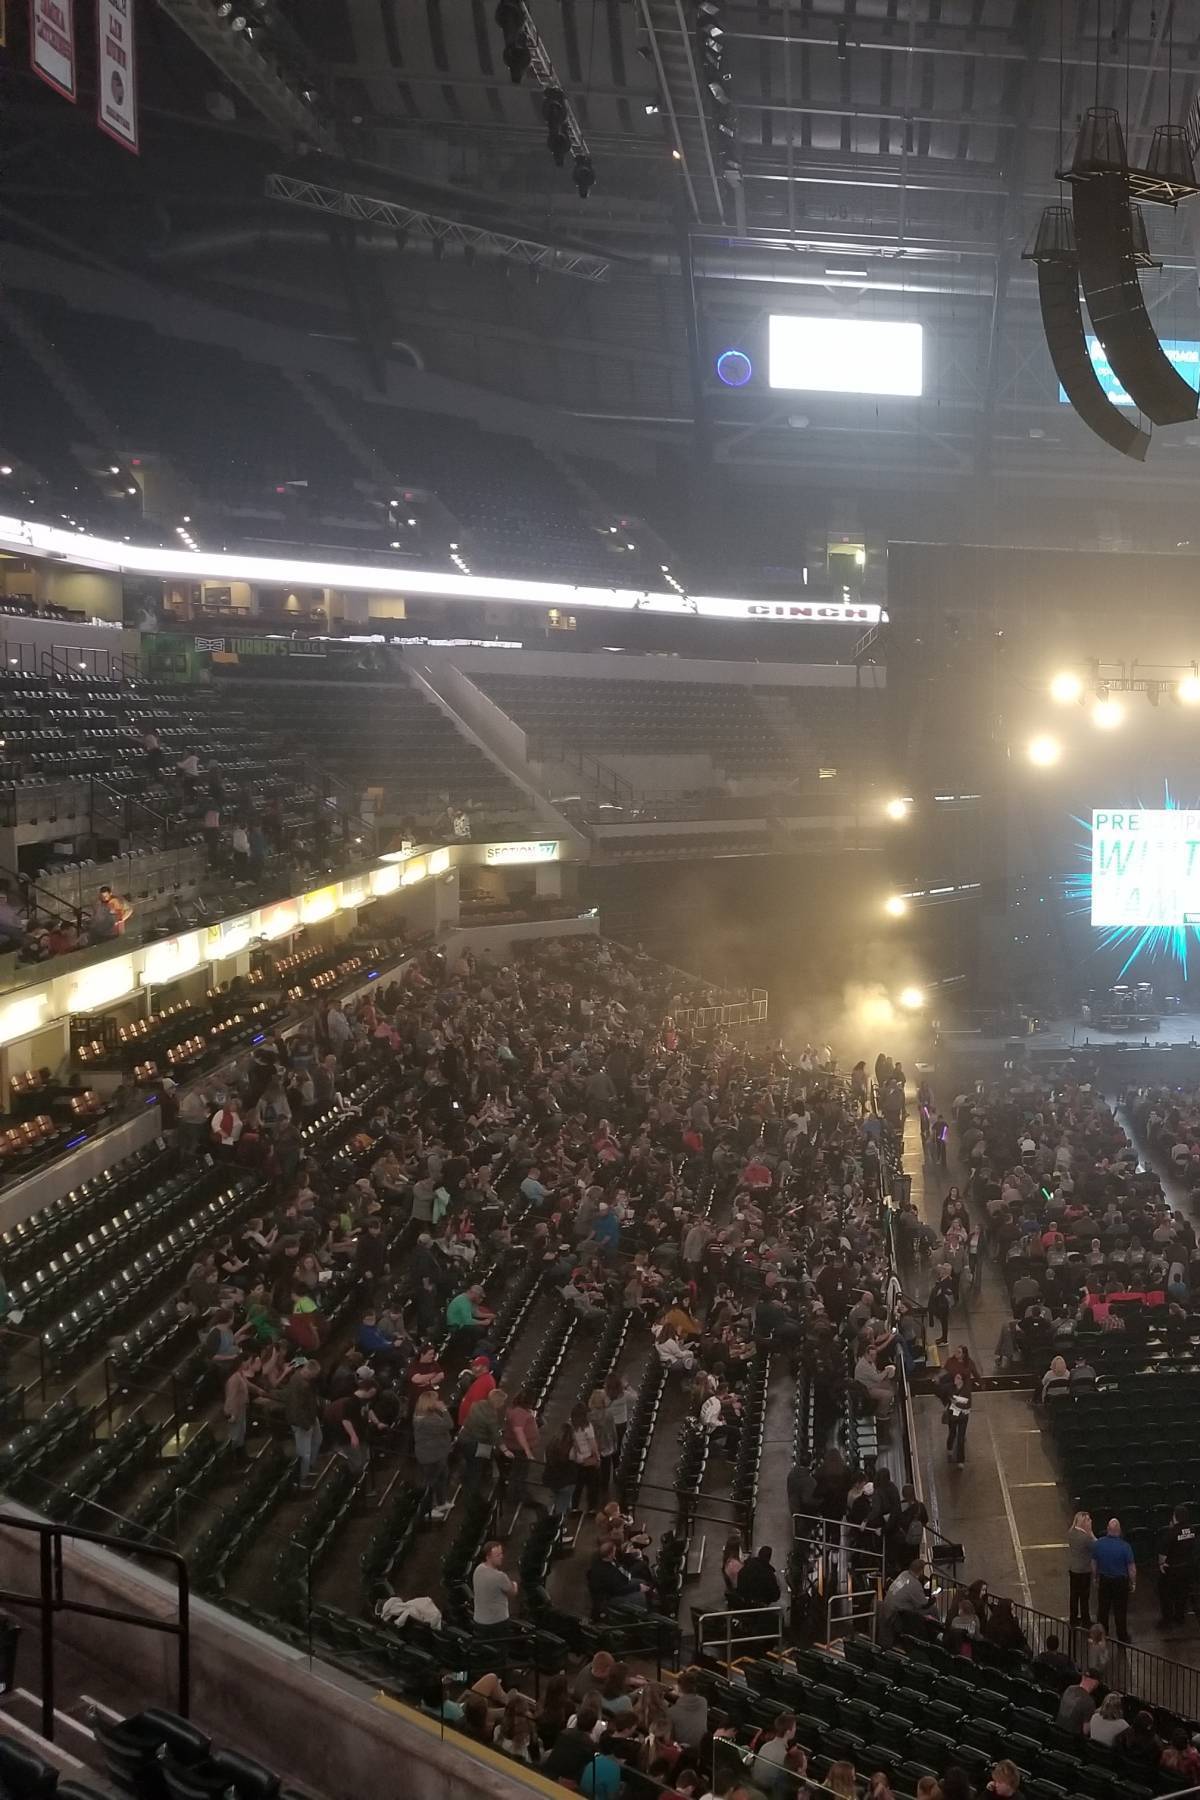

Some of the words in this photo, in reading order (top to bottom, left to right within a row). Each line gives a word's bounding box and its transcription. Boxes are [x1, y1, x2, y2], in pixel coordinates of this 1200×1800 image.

[747, 604, 868, 619] CINCH
[230, 638, 288, 656] TURNER'S
[1096, 814, 1140, 831] PRE
[487, 846, 536, 859] SECTION
